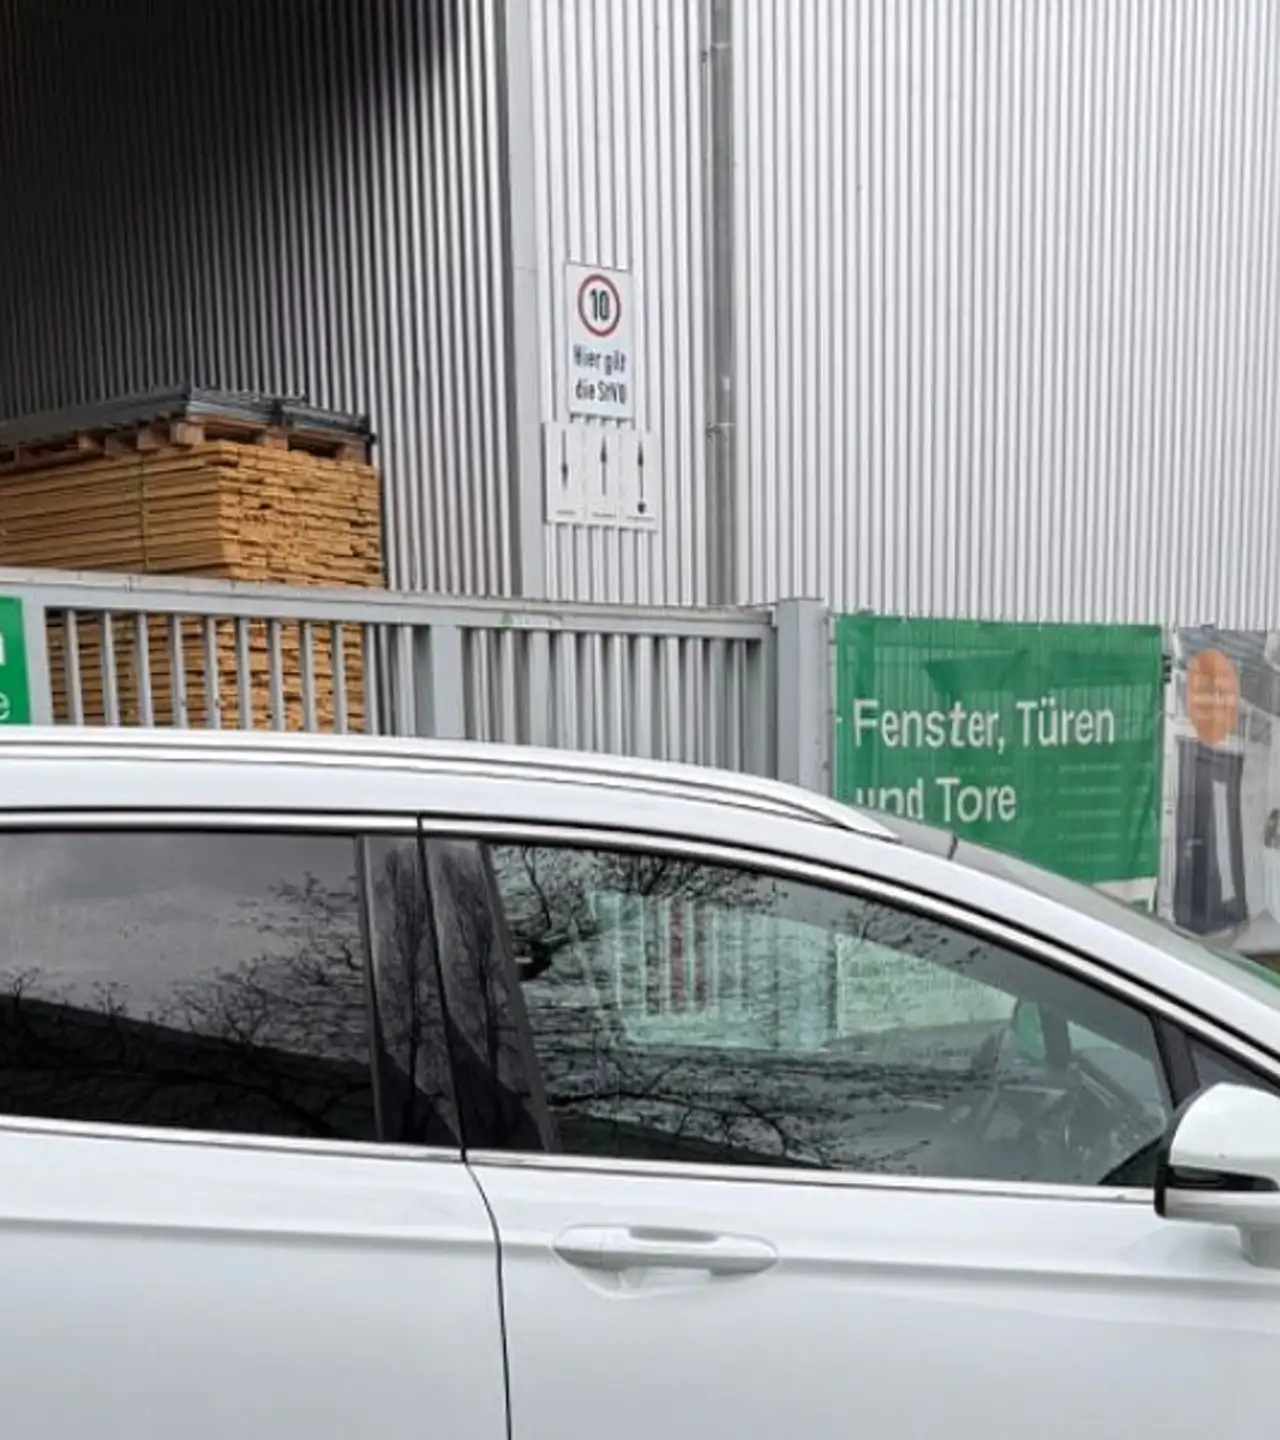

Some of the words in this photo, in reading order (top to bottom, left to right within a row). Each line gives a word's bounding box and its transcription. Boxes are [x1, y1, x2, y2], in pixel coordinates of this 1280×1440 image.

[589, 288, 610, 321] 10
[852, 699, 1005, 754] Fenster,
[1016, 696, 1115, 746] Türen
[935, 776, 1016, 823] Tore
